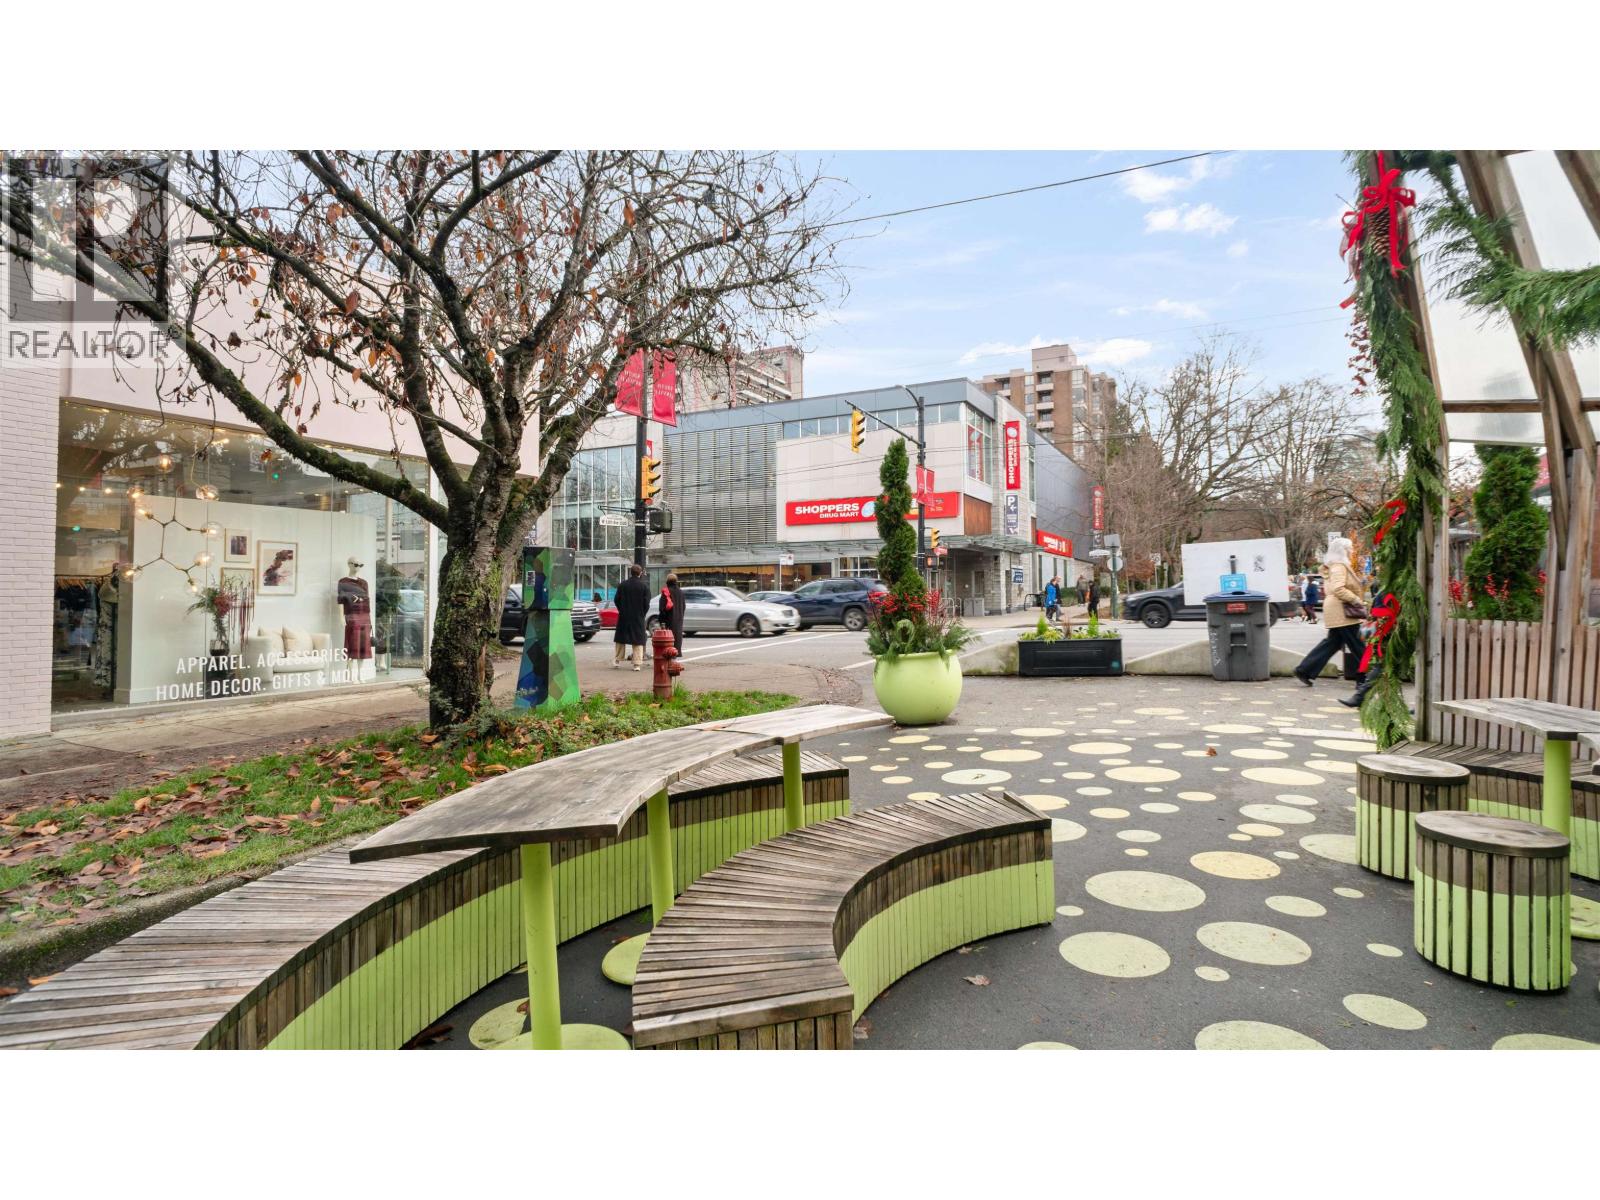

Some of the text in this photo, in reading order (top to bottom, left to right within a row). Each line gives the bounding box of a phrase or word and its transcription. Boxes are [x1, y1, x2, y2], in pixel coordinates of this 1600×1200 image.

[795, 503, 859, 515] SHOPPERS
[839, 511, 859, 519] MART
[176, 646, 353, 675] APPAREL. ACCESSORIES.
[156, 681, 204, 701] HOME
[211, 675, 267, 697] DECOR.
[272, 671, 312, 690] GIFTS
[316, 670, 327, 686] &
